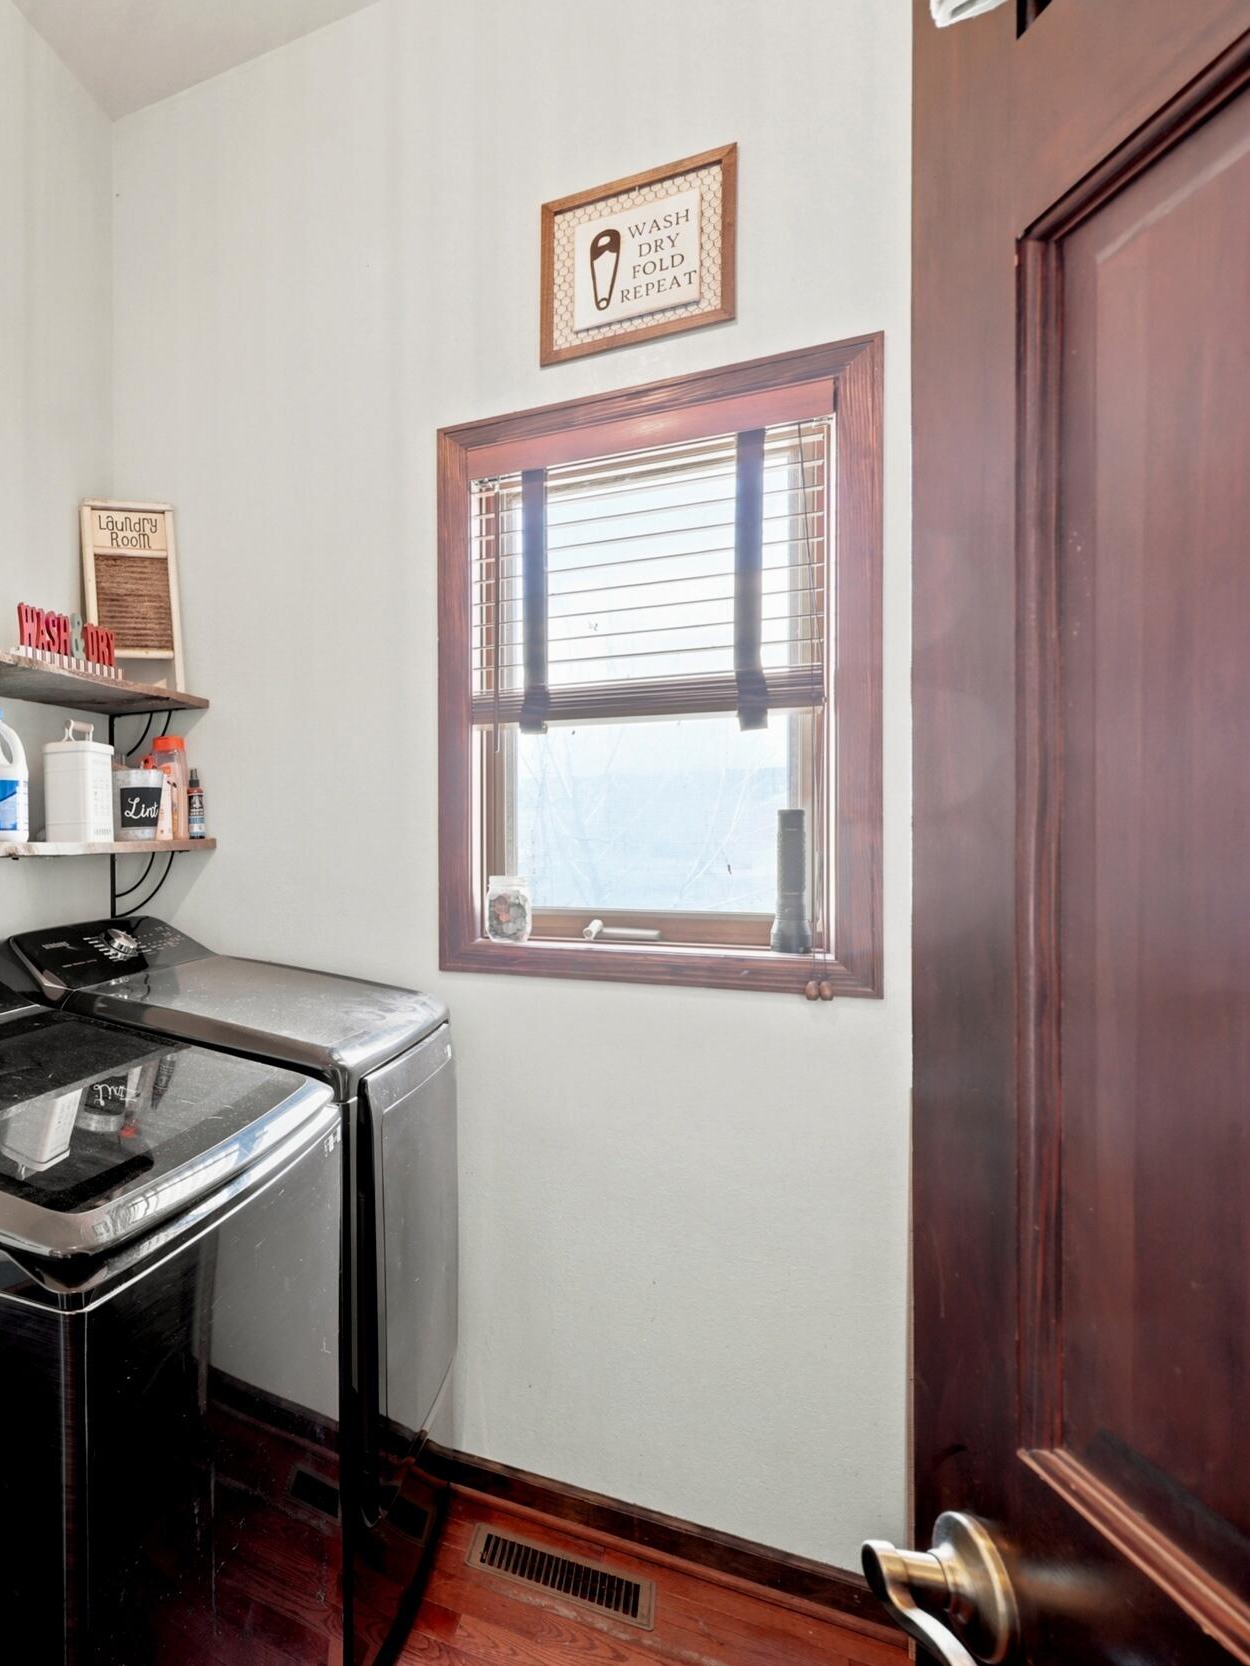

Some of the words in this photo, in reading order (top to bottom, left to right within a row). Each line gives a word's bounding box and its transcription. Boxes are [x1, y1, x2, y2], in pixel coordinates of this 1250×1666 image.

[628, 208, 691, 239] WASH
[638, 232, 681, 258] DRY
[631, 252, 685, 280] FOLD
[620, 270, 698, 303] REPEAT
[97, 514, 158, 534] Laundry
[17, 602, 71, 656] WASH
[83, 622, 117, 667] DRY
[124, 797, 159, 820] Lint
